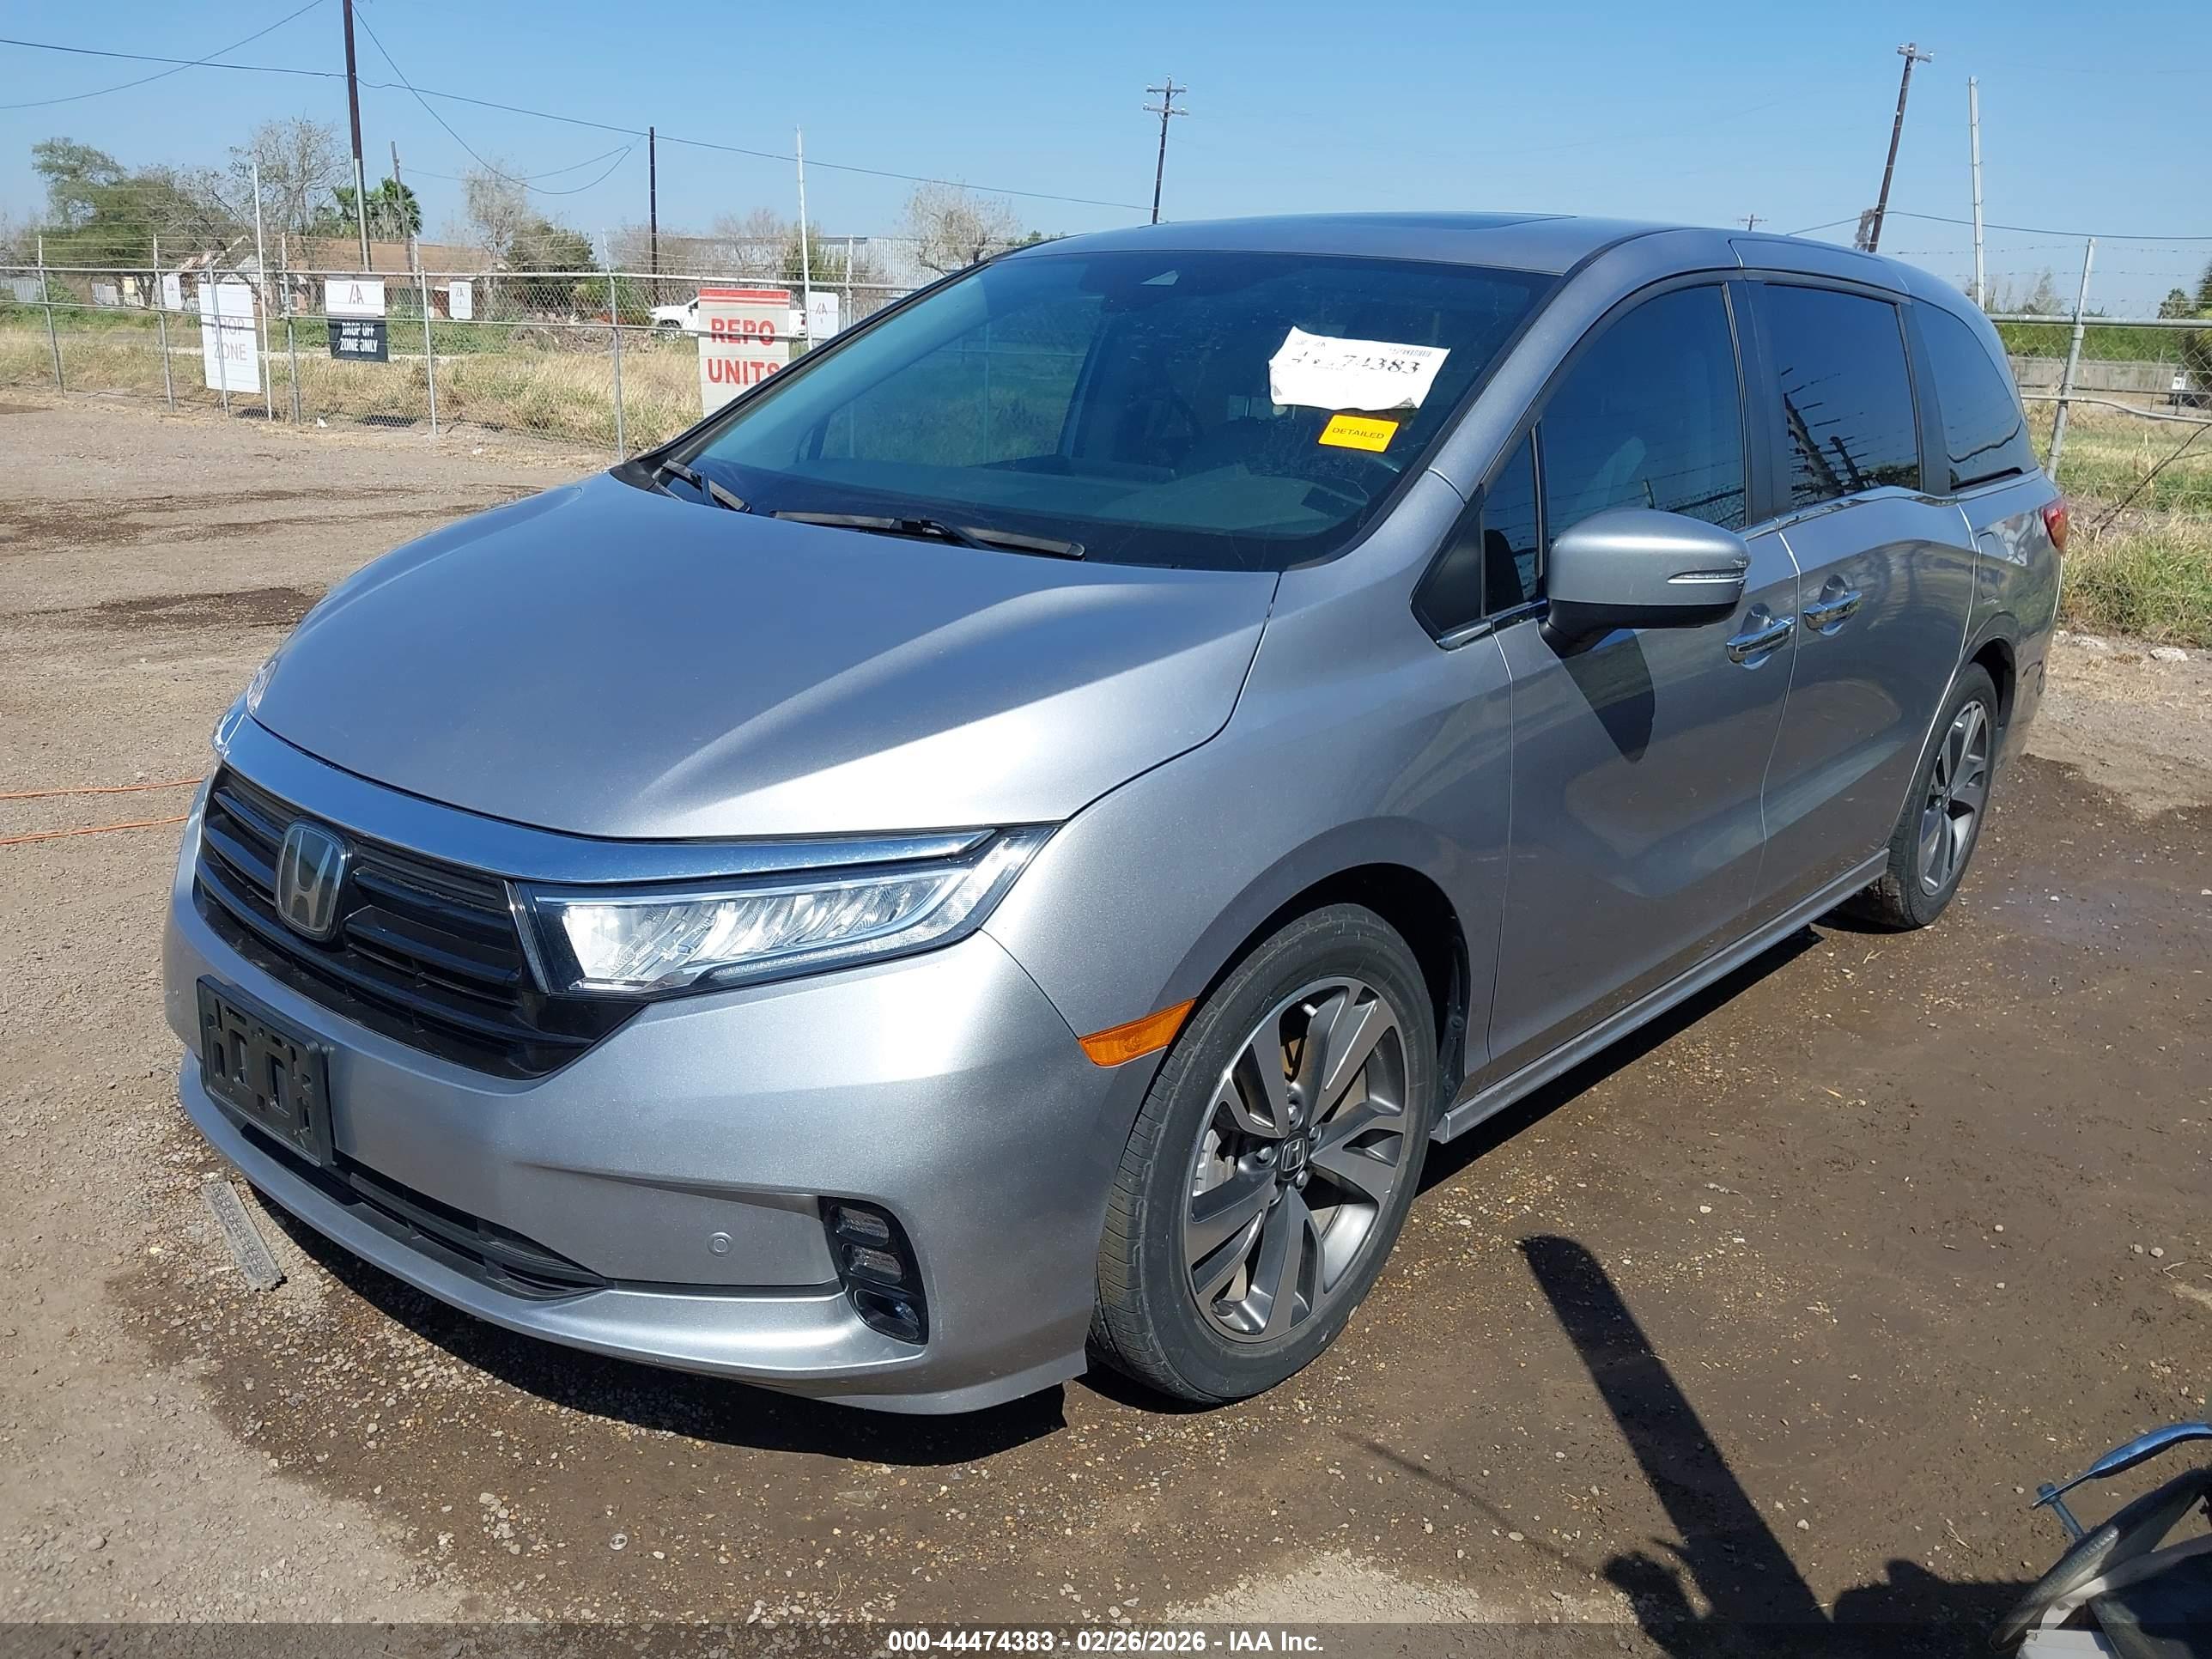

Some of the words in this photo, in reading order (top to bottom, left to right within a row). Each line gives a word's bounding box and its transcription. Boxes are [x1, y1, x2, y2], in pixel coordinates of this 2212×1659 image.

[342, 322, 361, 337] DROP
[362, 323, 375, 337] OFF
[711, 318, 775, 346] REPO
[213, 342, 248, 362] ZONE
[339, 337, 359, 352] ZONE
[359, 339, 378, 353] ONLY
[1332, 427, 1385, 440] DETAILED
